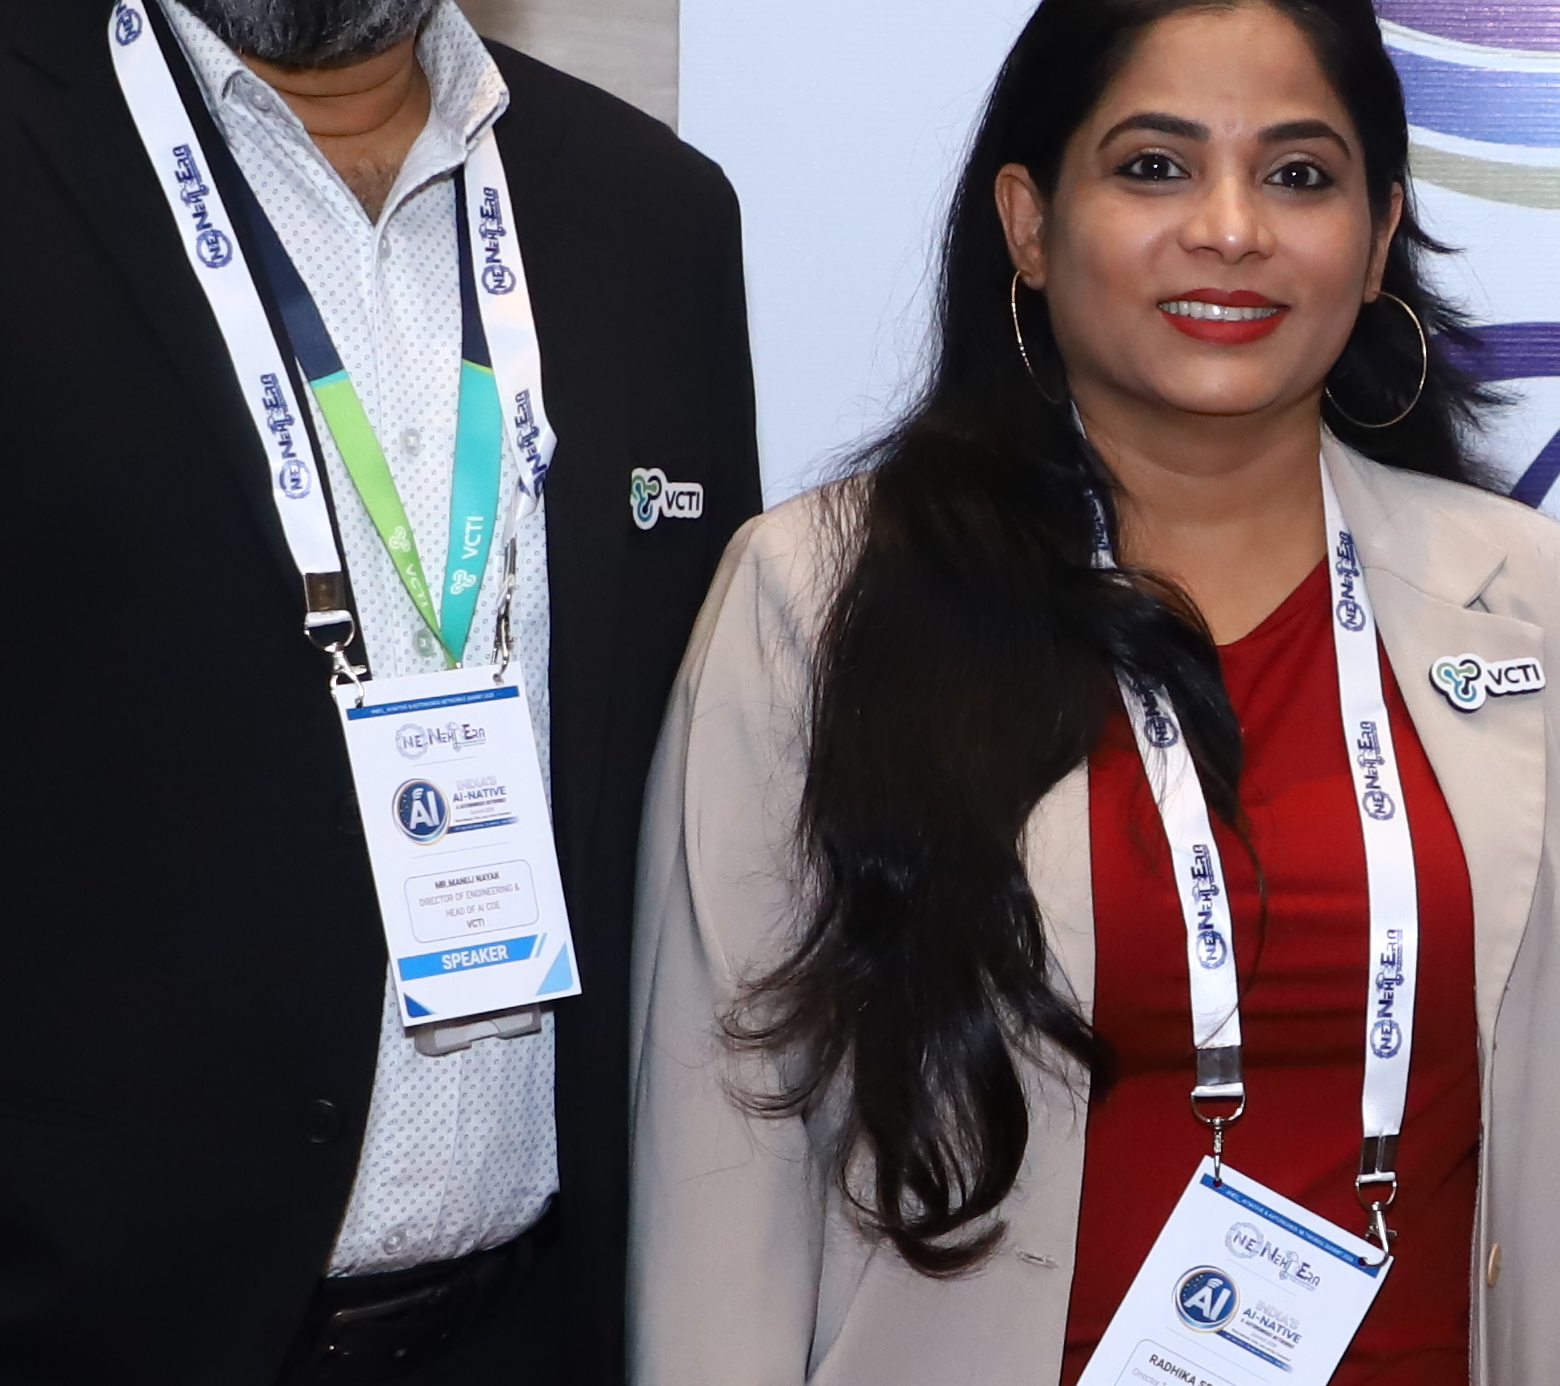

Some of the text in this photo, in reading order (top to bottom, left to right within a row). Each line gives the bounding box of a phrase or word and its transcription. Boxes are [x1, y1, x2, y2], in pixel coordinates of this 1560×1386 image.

[665, 490, 700, 511] VCTI
[461, 515, 484, 560] VCTI
[1487, 663, 1541, 686] VCTI
[409, 790, 441, 831] AI
[466, 917, 485, 929] VCTI
[441, 944, 509, 970] SPEAKER
[1184, 1287, 1232, 1321] AI
[1242, 1308, 1303, 1344] AI-NATIVE
[1148, 1353, 1197, 1386] RADHIKA
